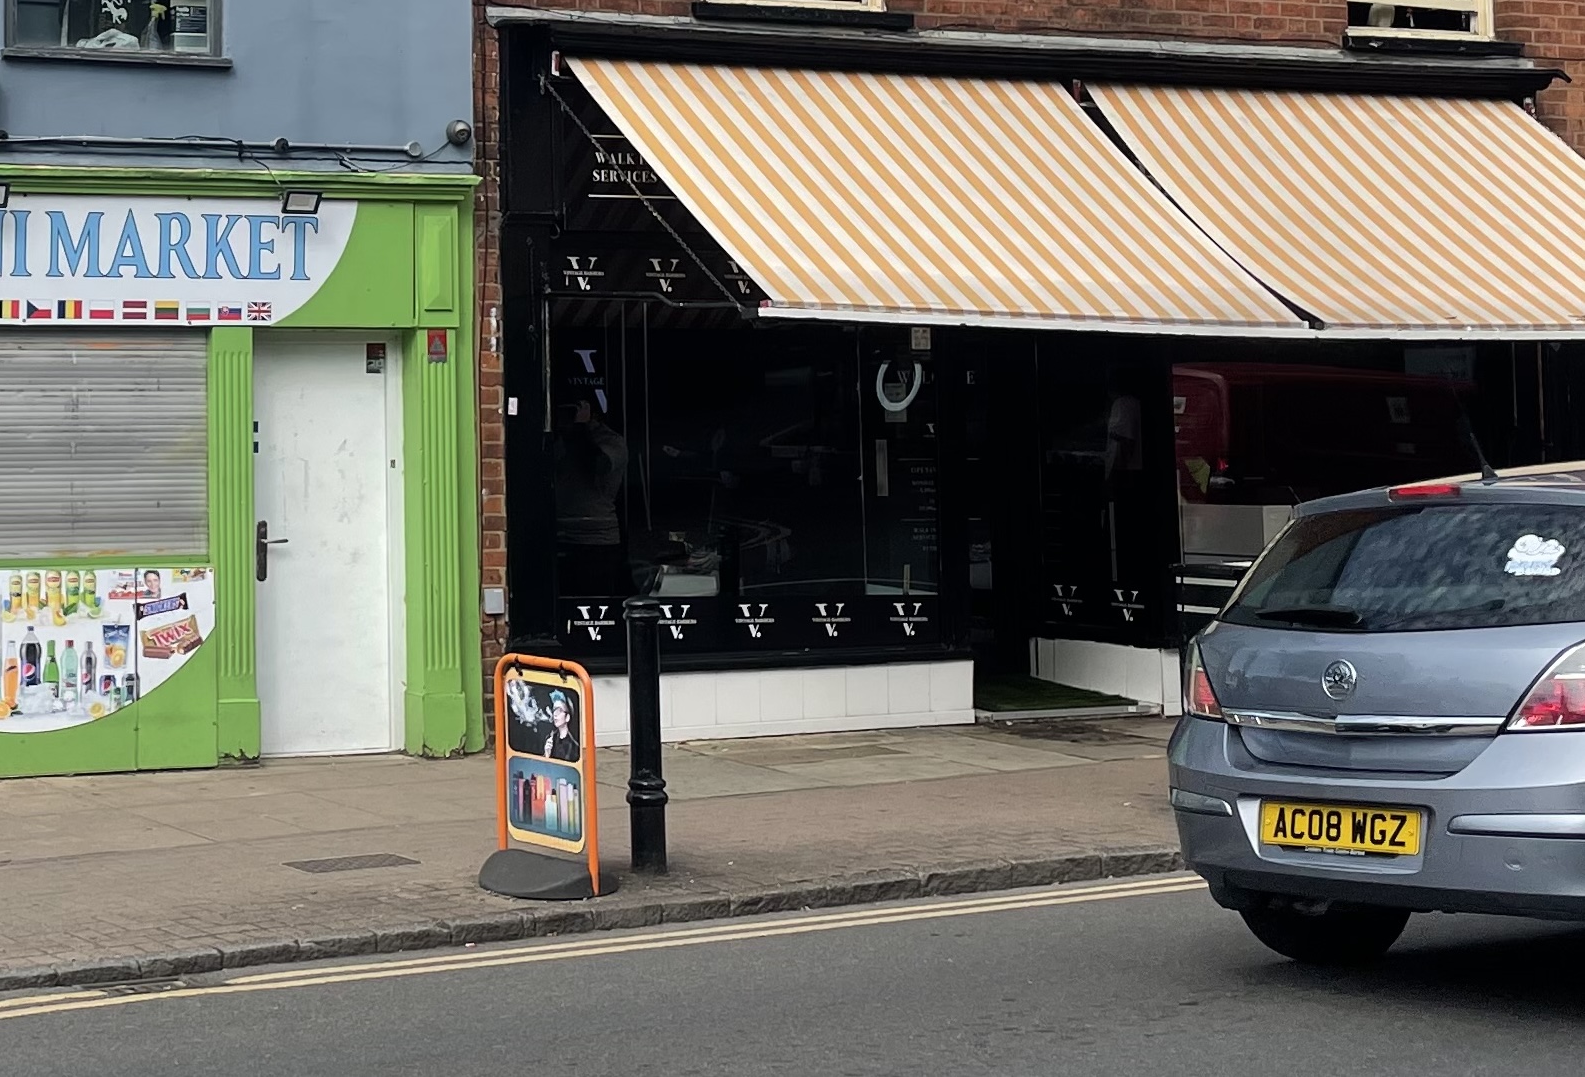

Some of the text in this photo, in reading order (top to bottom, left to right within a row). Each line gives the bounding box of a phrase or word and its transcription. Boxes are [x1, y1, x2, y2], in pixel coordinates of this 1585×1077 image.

[595, 152, 635, 165] WALK
[592, 169, 658, 183] SERVICES
[45, 208, 319, 280] MARKET
[1273, 807, 1408, 847] AC08 WGZ
